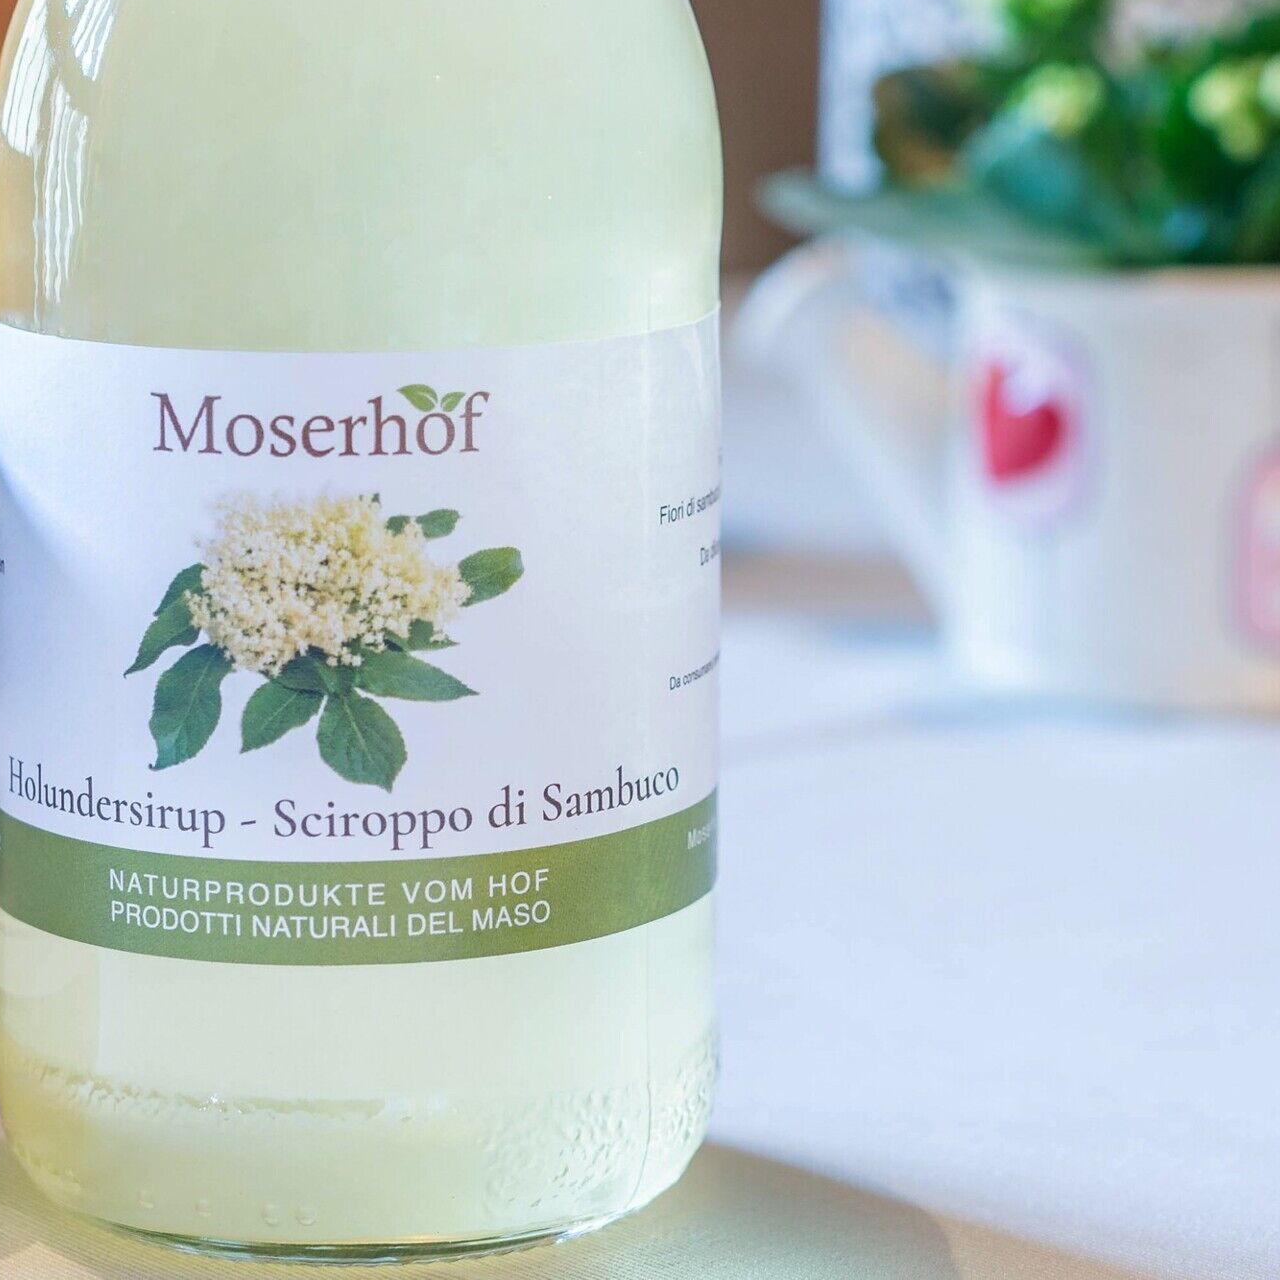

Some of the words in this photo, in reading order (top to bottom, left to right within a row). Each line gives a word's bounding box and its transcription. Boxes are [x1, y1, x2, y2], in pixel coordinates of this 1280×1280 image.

[150, 389, 489, 458] Moserhof
[660, 501, 684, 525] Fiori
[8, 756, 226, 849] Holundersirup
[273, 798, 473, 851] Sciroppo
[488, 787, 527, 830] di
[541, 765, 681, 822] Sambuco
[108, 868, 386, 907] NATURPRODUKTE
[402, 877, 474, 904] VOM
[488, 868, 550, 898] HOF
[110, 902, 243, 938] PRODOTTI
[252, 912, 398, 940] NATURALI
[408, 909, 463, 936] DEL
[472, 899, 551, 930] MASO
